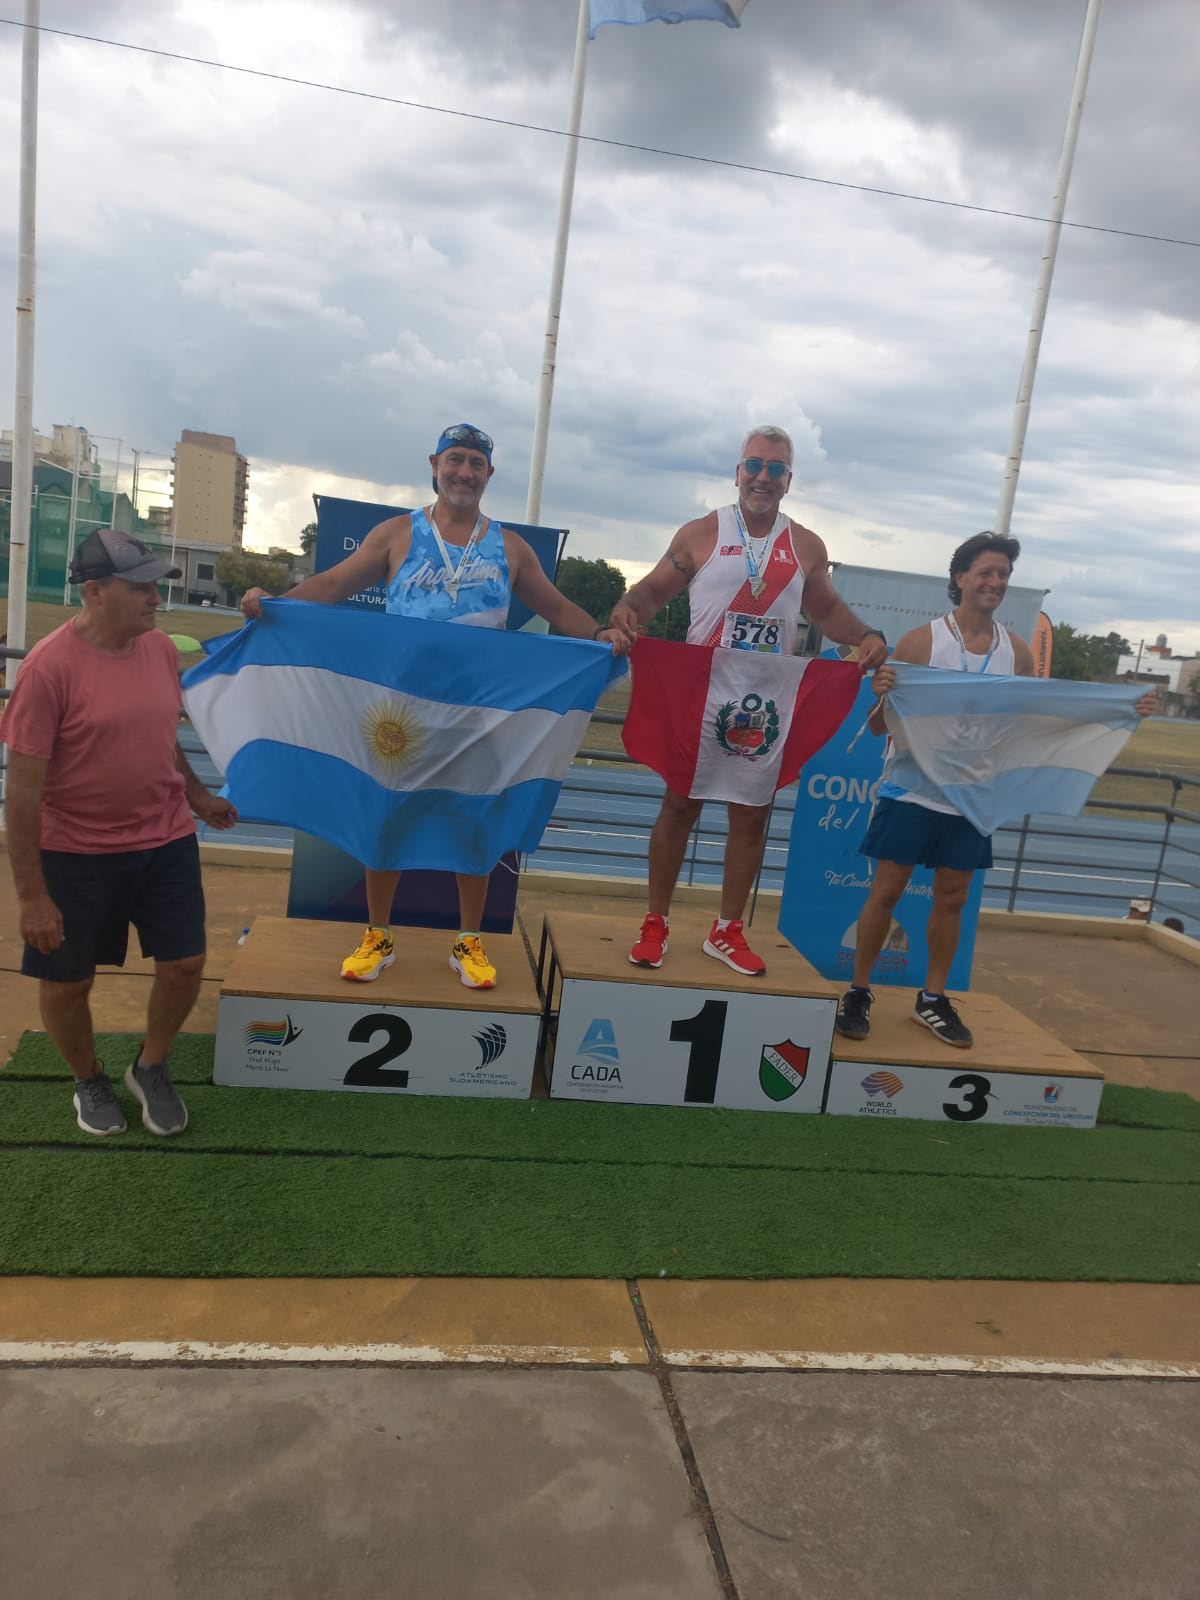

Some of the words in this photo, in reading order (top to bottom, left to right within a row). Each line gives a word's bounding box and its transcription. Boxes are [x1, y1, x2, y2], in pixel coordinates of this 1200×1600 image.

[343, 536, 360, 551] Di
[347, 594, 389, 605] ULTURA
[731, 621, 780, 645] 578
[807, 773, 880, 806] CONC
[818, 804, 860, 831] del
[343, 1013, 413, 1089] 2
[669, 999, 729, 1105] 1
[460, 1072, 508, 1080] ATLETISMO
[571, 1065, 622, 1083] CADA
[768, 1052, 798, 1083] FADER
[449, 1077, 518, 1087] SUDAMERICANO
[866, 1100, 892, 1108] WORLD
[942, 1073, 992, 1122] 3
[858, 1106, 898, 1116] ATHLETICS
